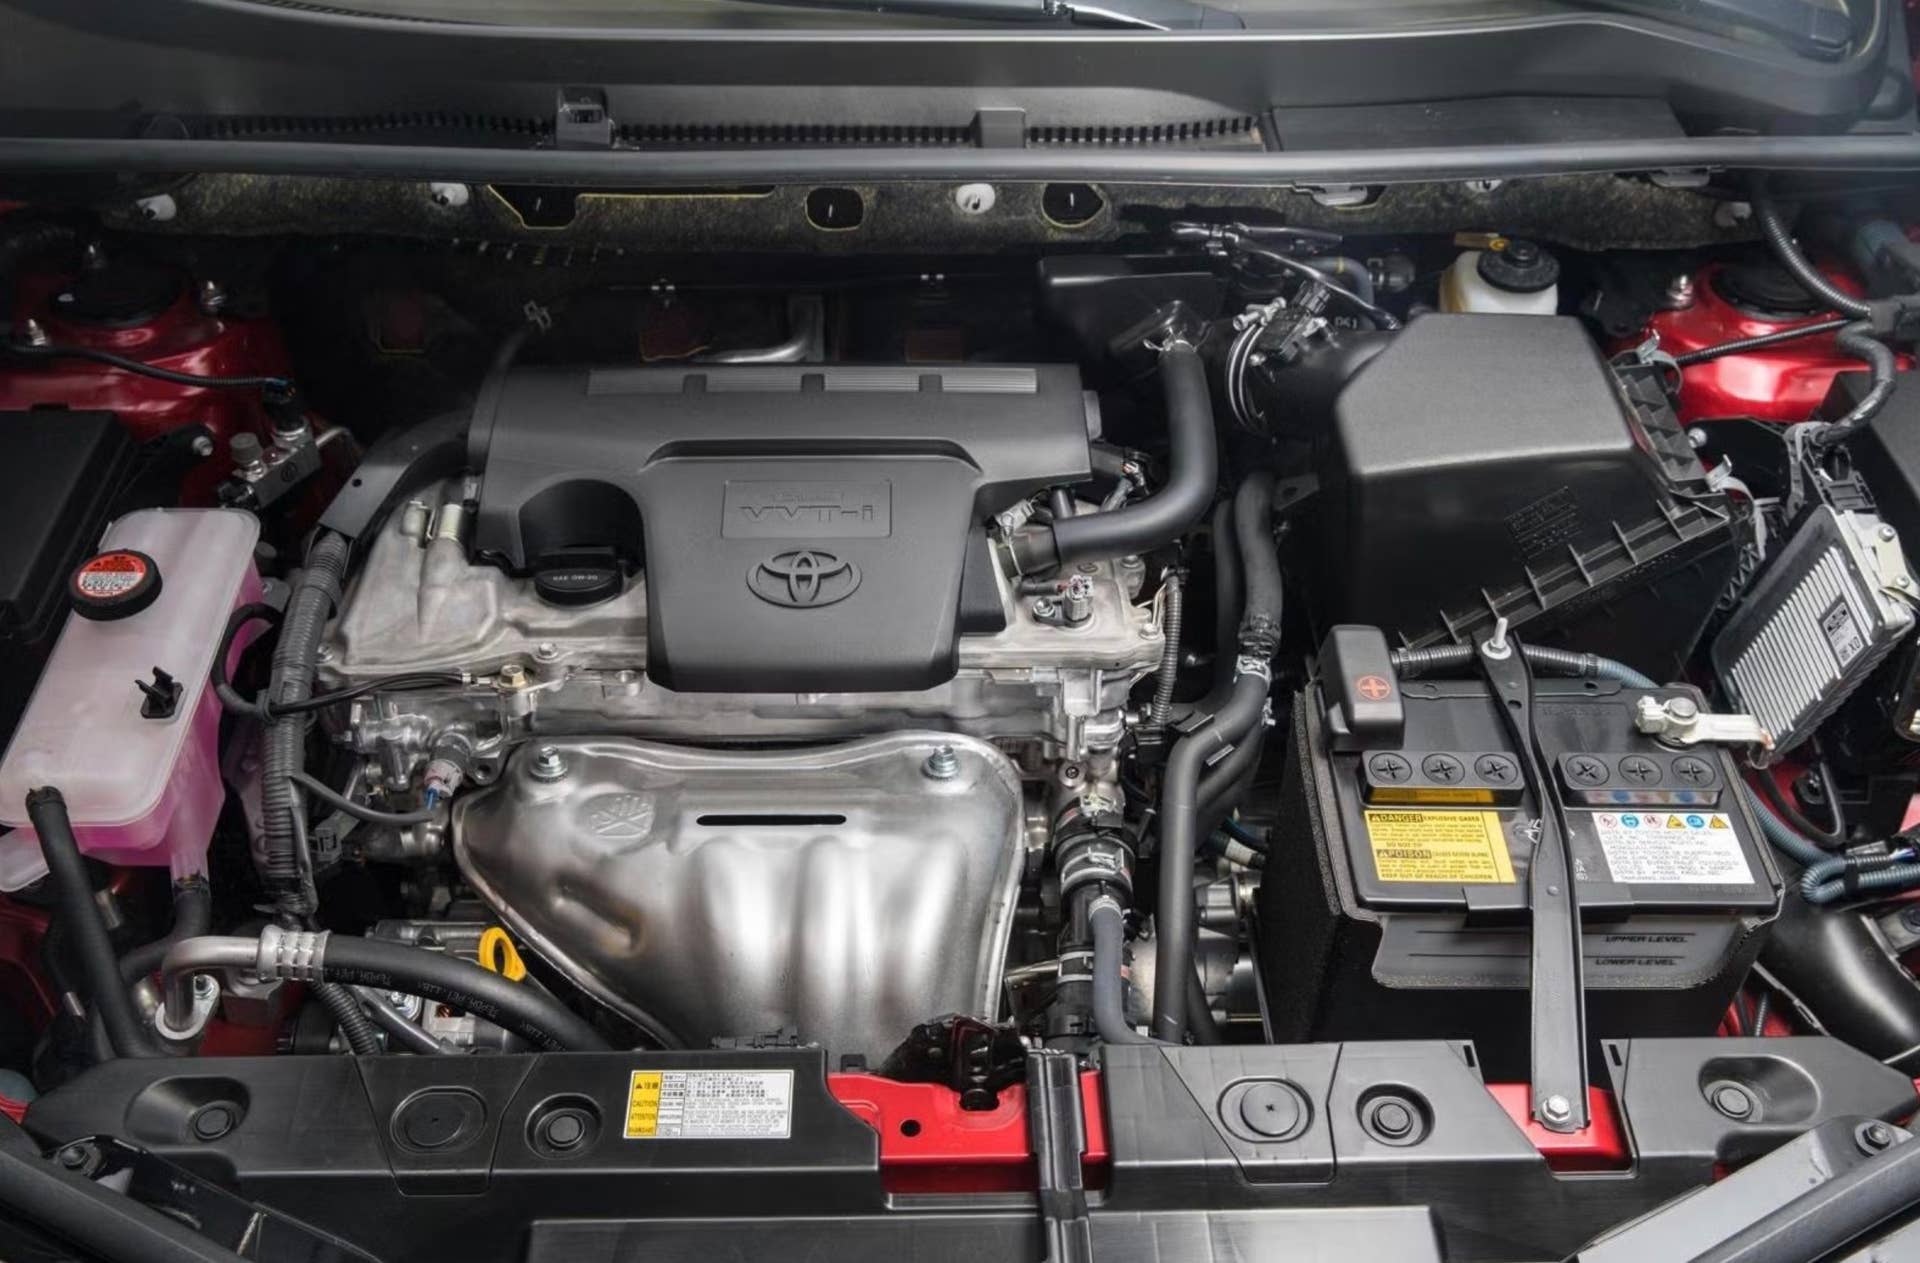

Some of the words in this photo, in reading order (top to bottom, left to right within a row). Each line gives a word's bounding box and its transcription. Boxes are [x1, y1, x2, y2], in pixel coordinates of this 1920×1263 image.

[1380, 814, 1423, 823] DANGER
[1389, 849, 1431, 859] POISON
[1605, 935, 1646, 943] UPPER
[1647, 935, 1688, 944] LEVEL
[1595, 958, 1637, 966] LOWER
[1637, 959, 1678, 967] LEVEL
